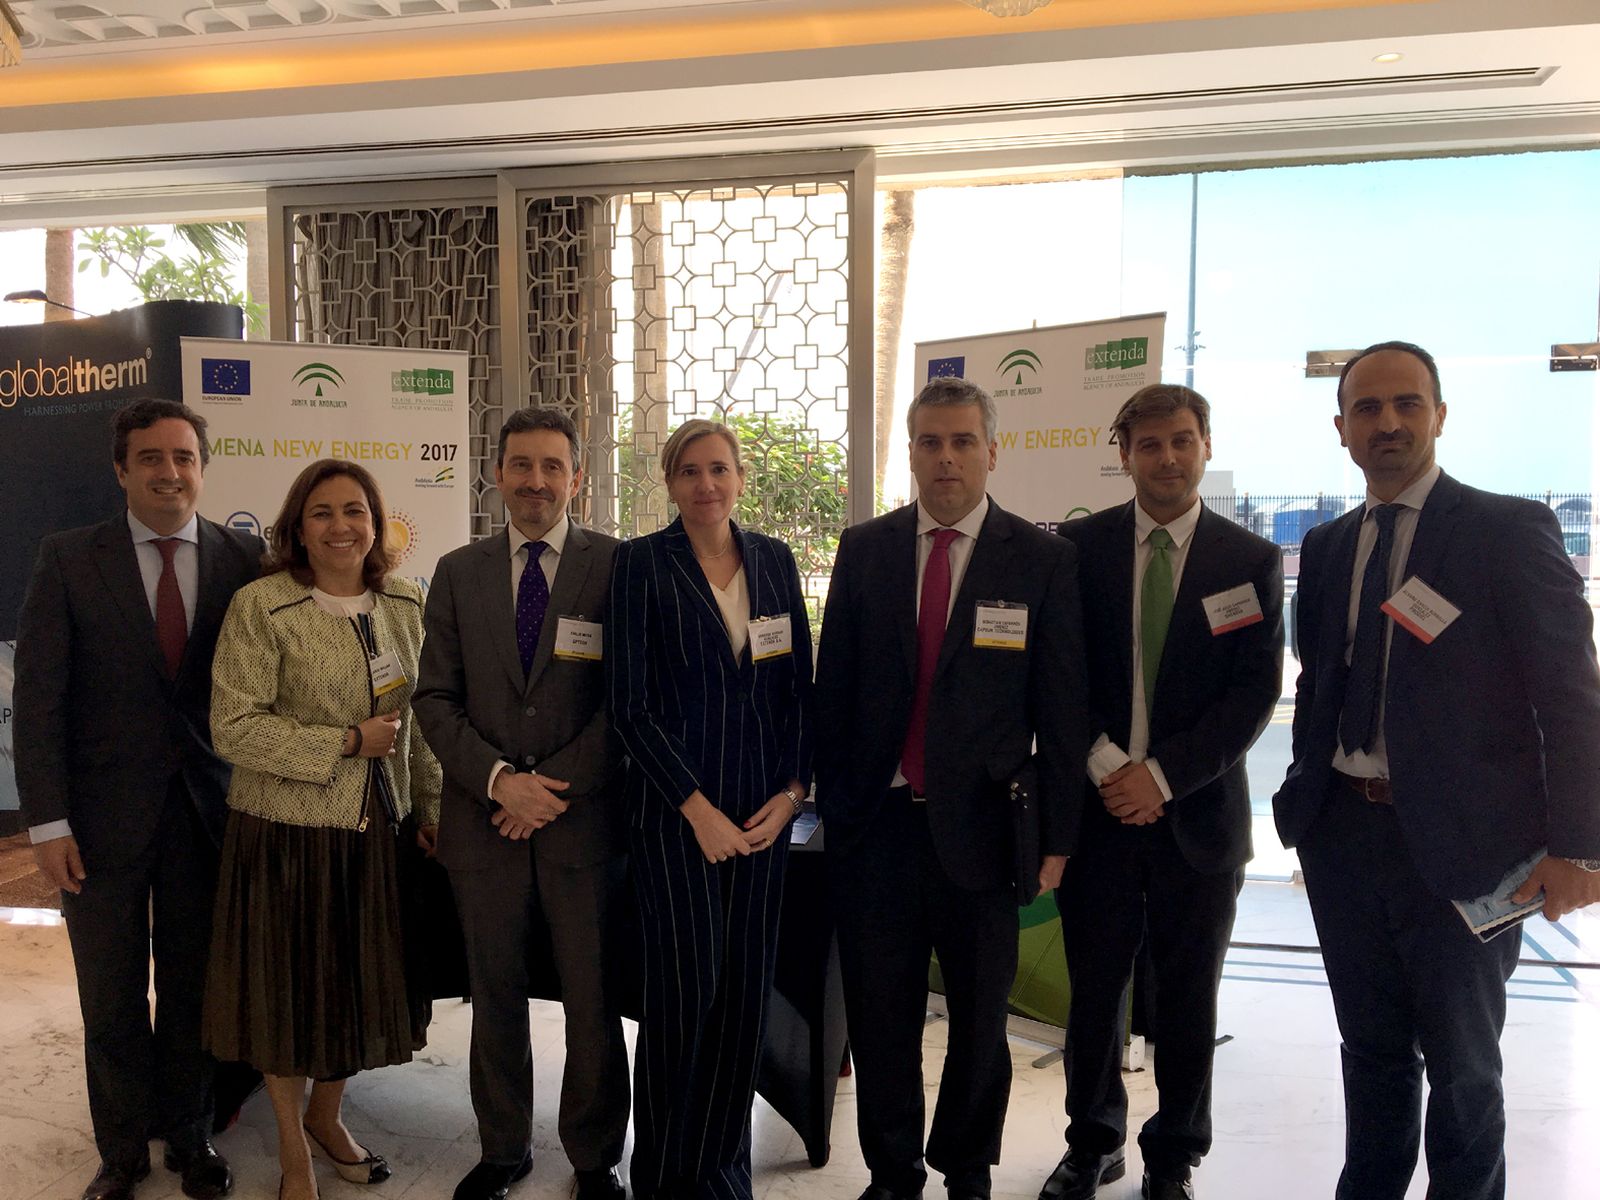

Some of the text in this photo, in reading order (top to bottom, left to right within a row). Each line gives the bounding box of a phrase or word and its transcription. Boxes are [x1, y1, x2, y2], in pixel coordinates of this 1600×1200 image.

[1086, 342, 1145, 364] extenda
[393, 373, 451, 389] extenda
[1010, 388, 1017, 397] DE
[24, 404, 78, 417] HARNESSING
[1024, 426, 1102, 450] ENERGY
[208, 438, 458, 461] MENA NEW ENERGY 2017
